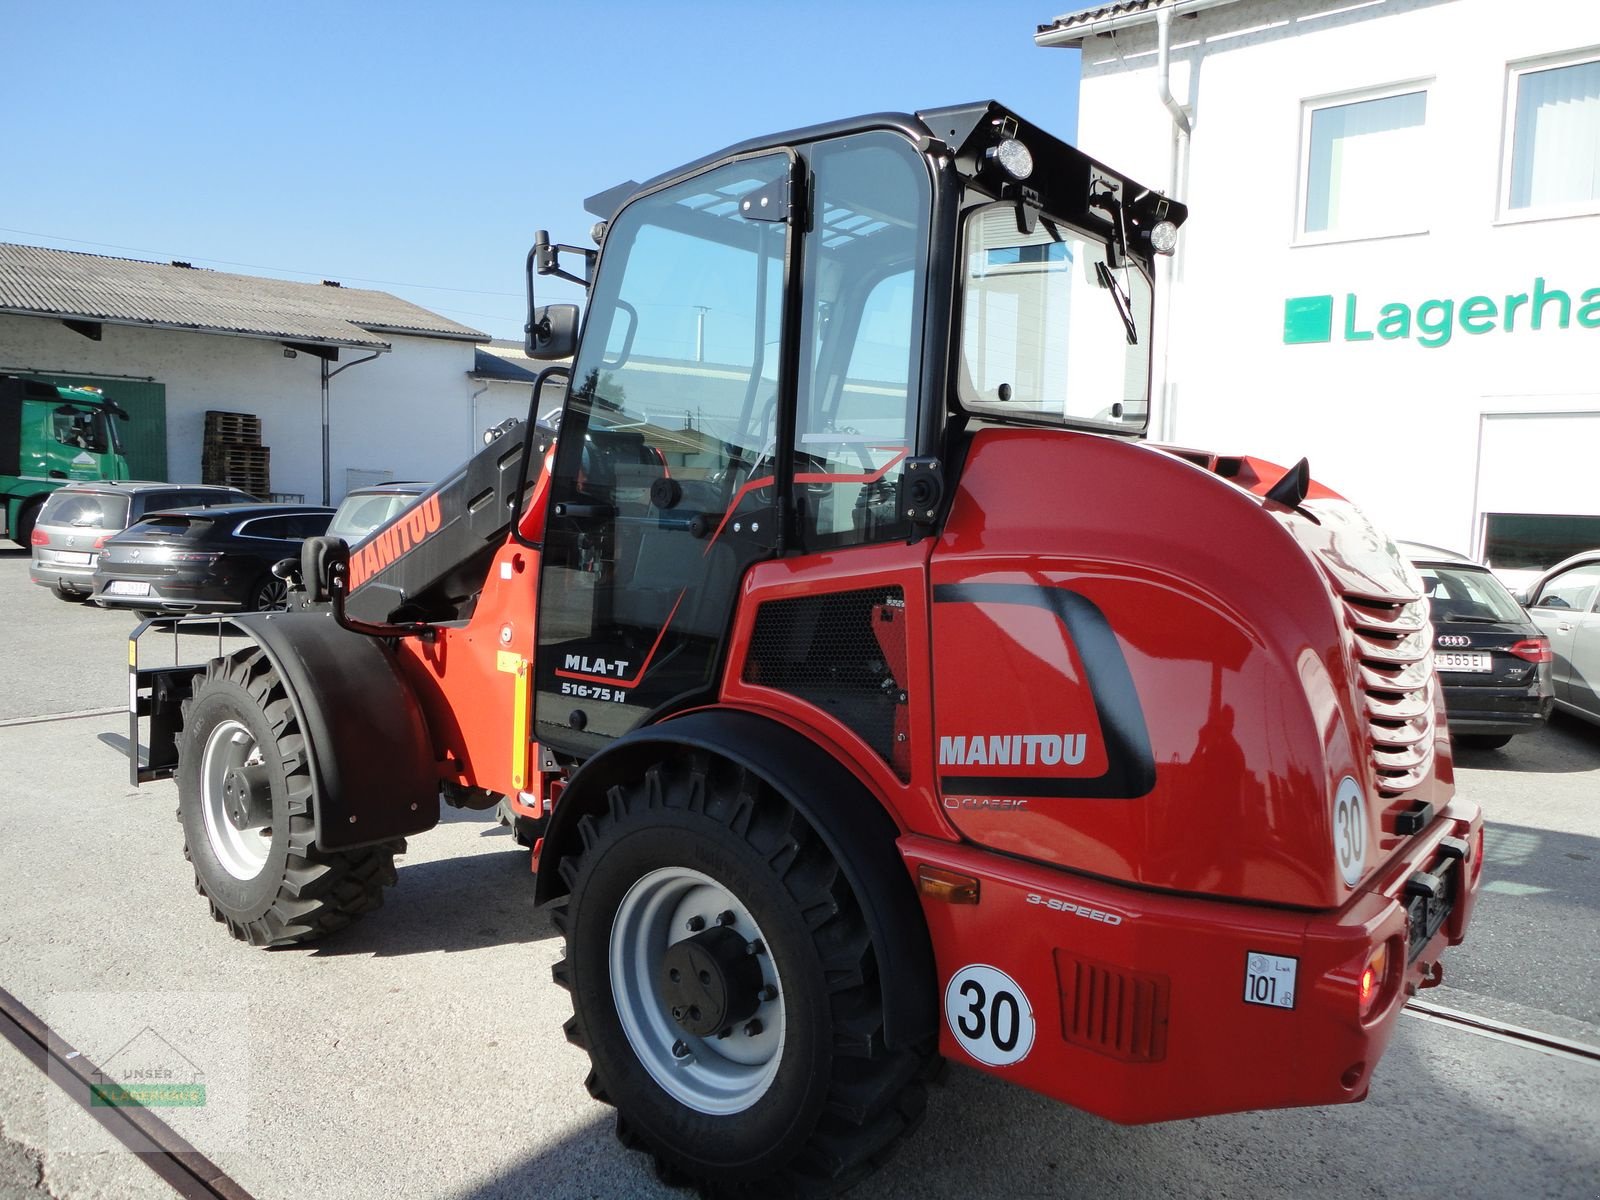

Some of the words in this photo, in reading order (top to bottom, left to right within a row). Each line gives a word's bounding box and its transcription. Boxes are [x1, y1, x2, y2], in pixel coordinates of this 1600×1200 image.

[1344, 277, 1600, 348] Lagerha
[349, 492, 441, 592] MANITOU
[565, 654, 628, 676] MLA-T
[562, 682, 611, 700] 516-75
[614, 690, 626, 702] H
[939, 734, 1087, 765] MANITOU
[962, 798, 1028, 811] CLASSIC
[1338, 796, 1361, 868] 30
[1026, 893, 1122, 926] 3-SPEED
[1249, 974, 1277, 1003] 101
[957, 979, 1020, 1052] 30
